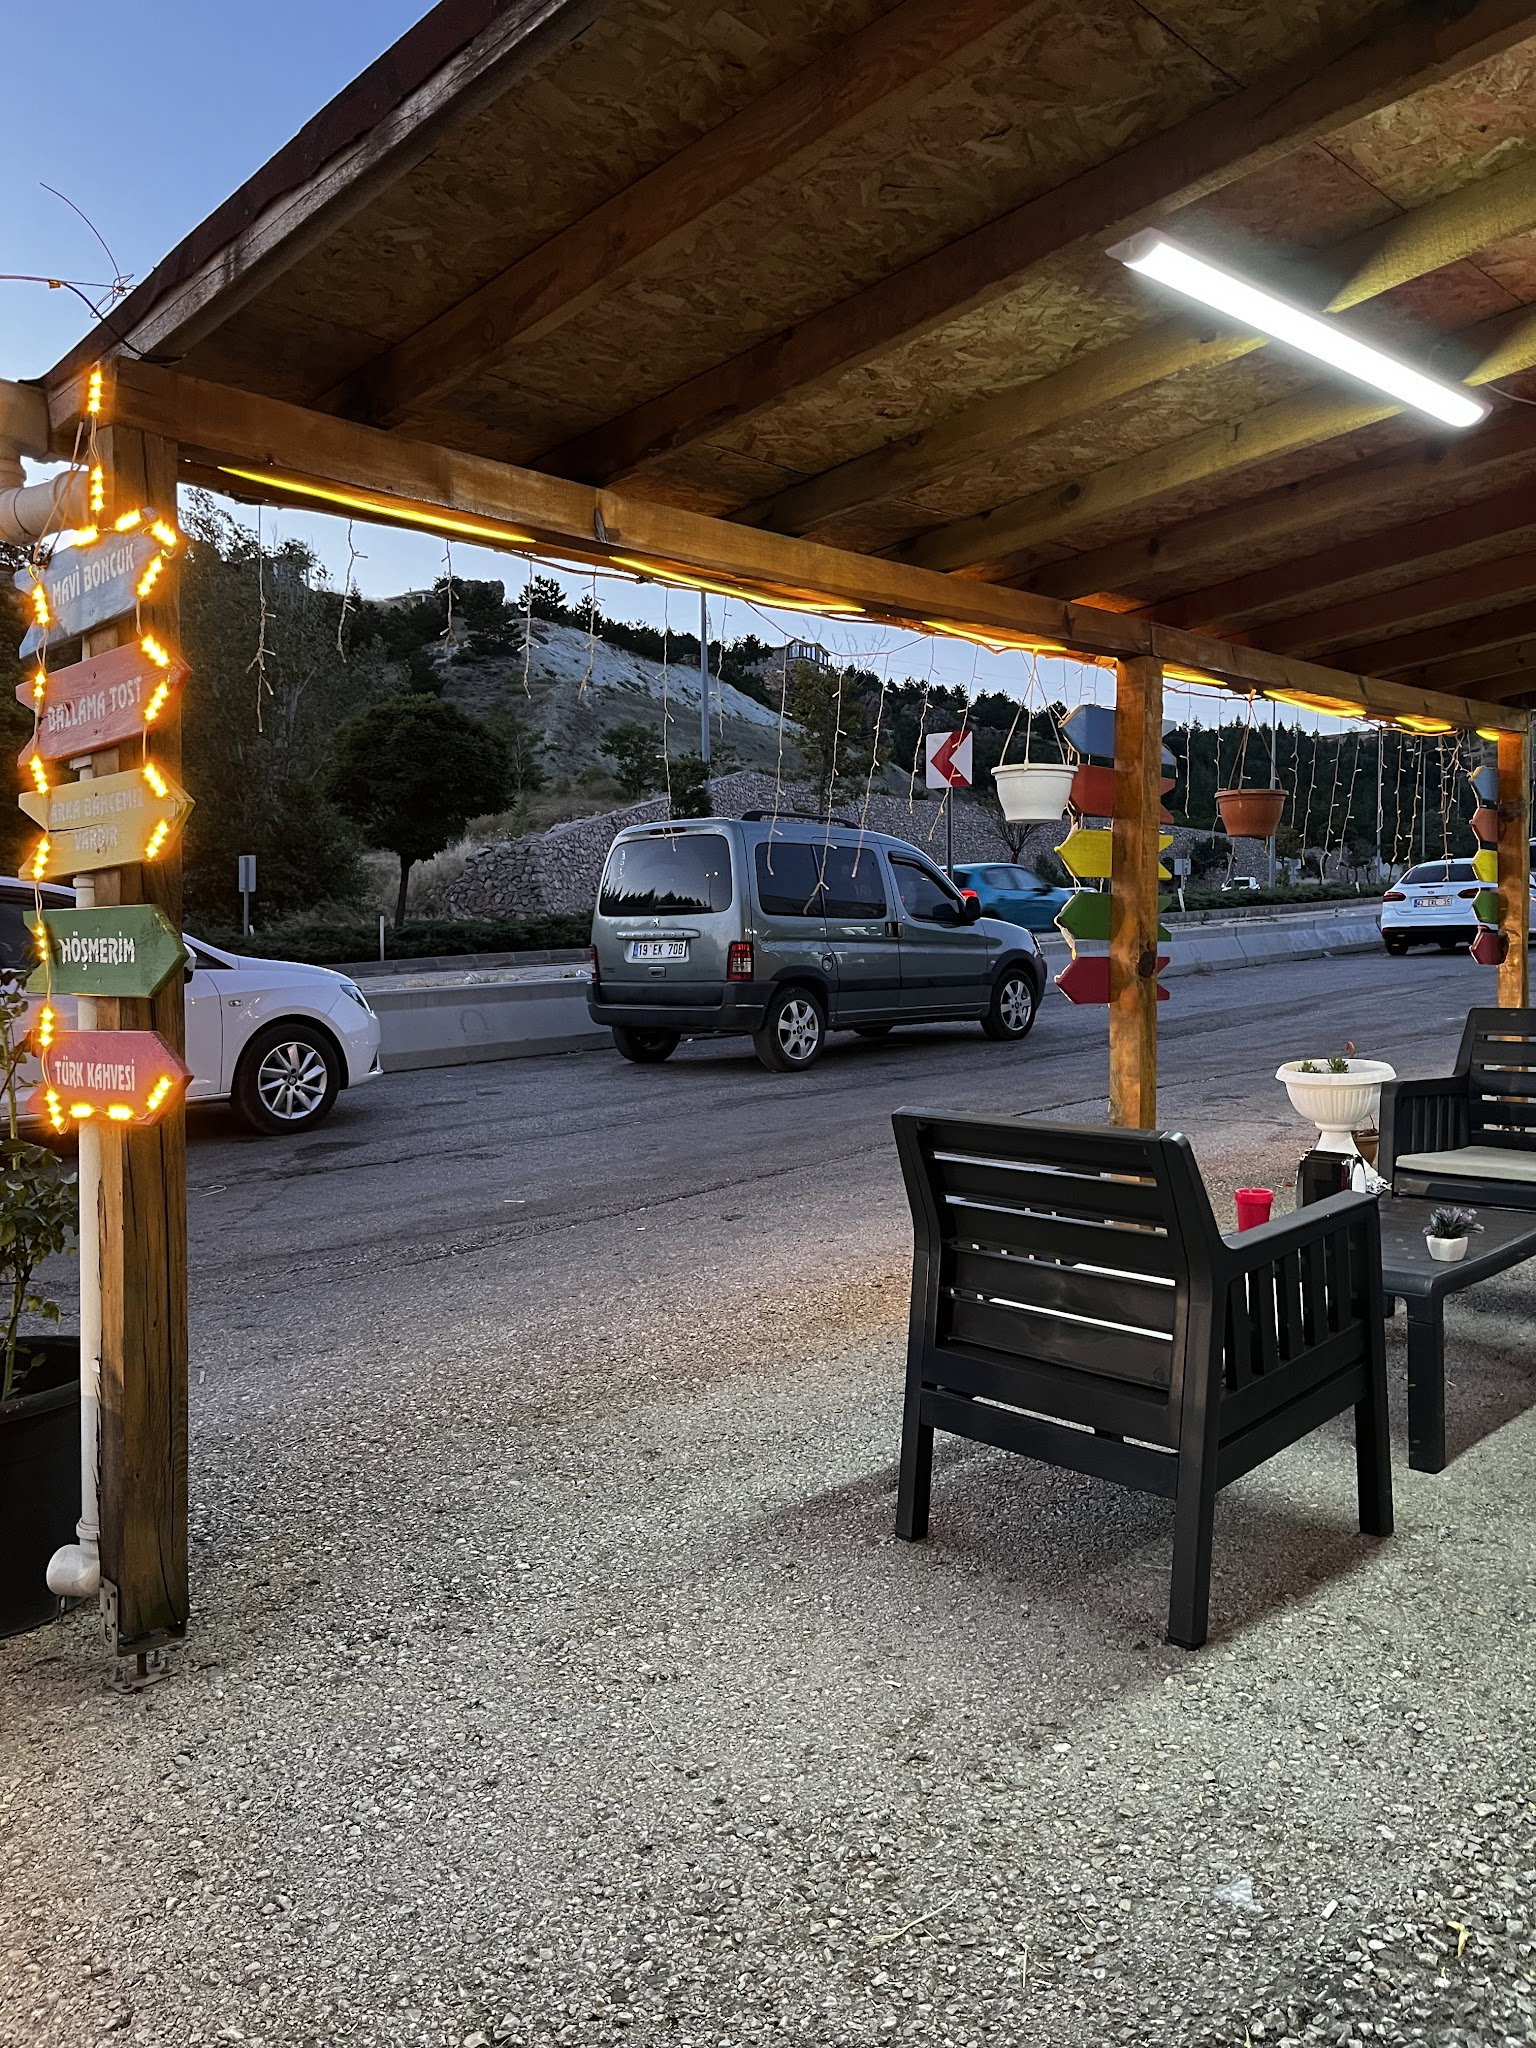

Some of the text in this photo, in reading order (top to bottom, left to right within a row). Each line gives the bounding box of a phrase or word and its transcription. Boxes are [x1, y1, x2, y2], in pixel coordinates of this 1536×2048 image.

[52, 543, 135, 606] MAVİ BONCUK
[109, 675, 143, 712] TOST
[51, 799, 81, 823] ARKA
[639, 944, 648, 956] 19
[652, 943, 663, 956] EK
[54, 1056, 136, 1091] TÜRK KAHVESİ
